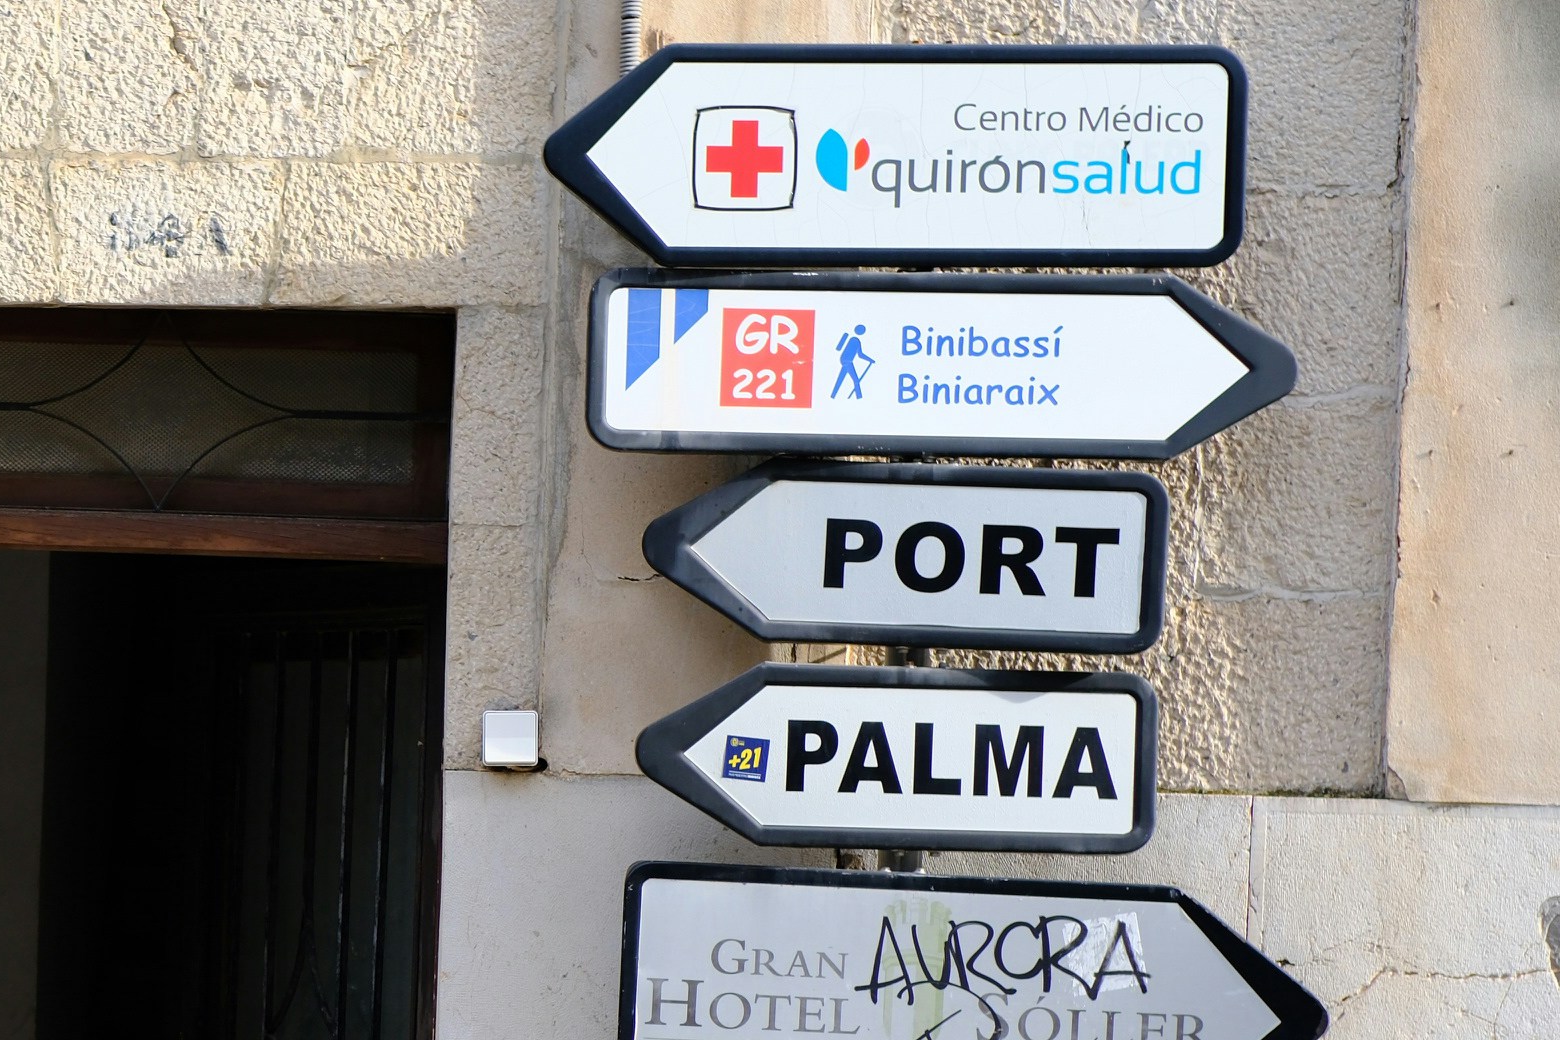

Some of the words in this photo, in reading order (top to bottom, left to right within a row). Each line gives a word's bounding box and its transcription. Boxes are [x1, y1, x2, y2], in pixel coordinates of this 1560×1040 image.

[953, 103, 1067, 132] Centro
[1078, 104, 1204, 133] Médico
[871, 149, 1202, 208] quirónsalud
[735, 314, 800, 356] GR
[901, 325, 1065, 360] Binibassí
[732, 368, 796, 401] 221
[897, 373, 1060, 407] Biniaraix
[822, 518, 1121, 599] PORT
[728, 746, 762, 770] +21
[785, 719, 1118, 801] PALMA
[710, 938, 849, 980] GRAN
[643, 977, 861, 1036] HOTEL
